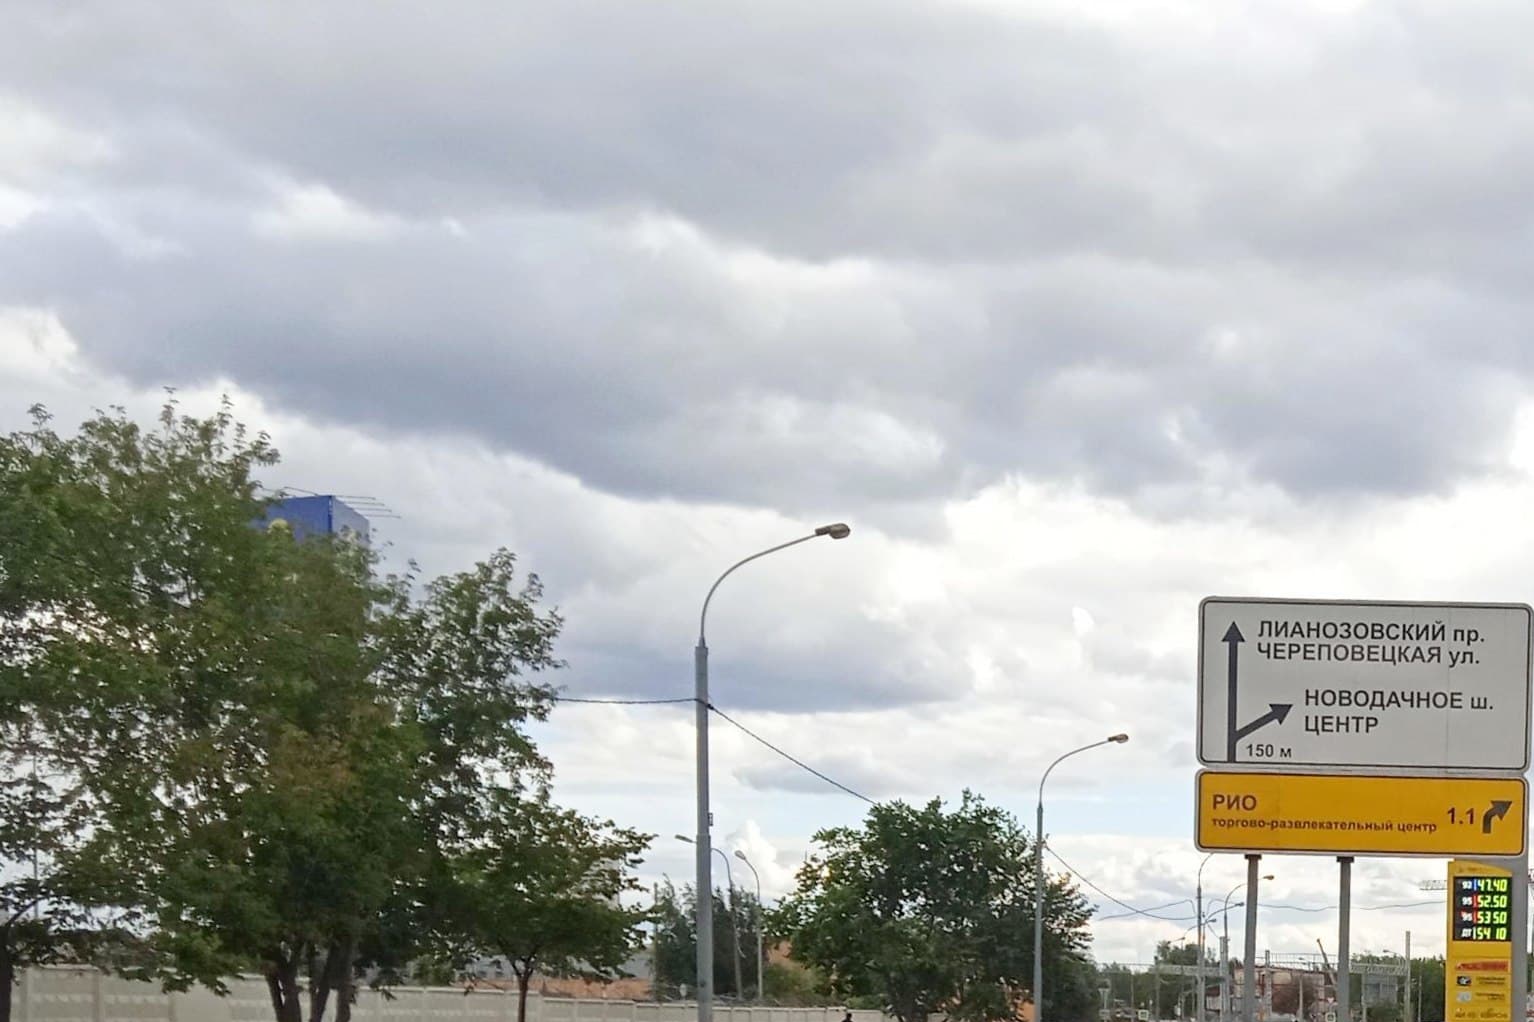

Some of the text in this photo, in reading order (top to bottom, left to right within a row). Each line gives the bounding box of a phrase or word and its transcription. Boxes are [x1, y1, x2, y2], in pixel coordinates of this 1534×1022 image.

[1258, 620, 1485, 646] ЛИАНОЗОВСКИЙ пр.
[1258, 643, 1480, 668] ЧЕРЕПОВЕЦКАЯ ул.
[1305, 689, 1494, 711] НОВОДАЧНОЕ ш.
[1304, 716, 1379, 735] ЦЕНТР
[1246, 744, 1292, 758] 150 м
[1213, 794, 1257, 811] РИО
[1447, 808, 1475, 825] 1.1
[1212, 817, 1437, 834] торгово-развлекательный центр
[1477, 895, 1507, 908] 52.50
